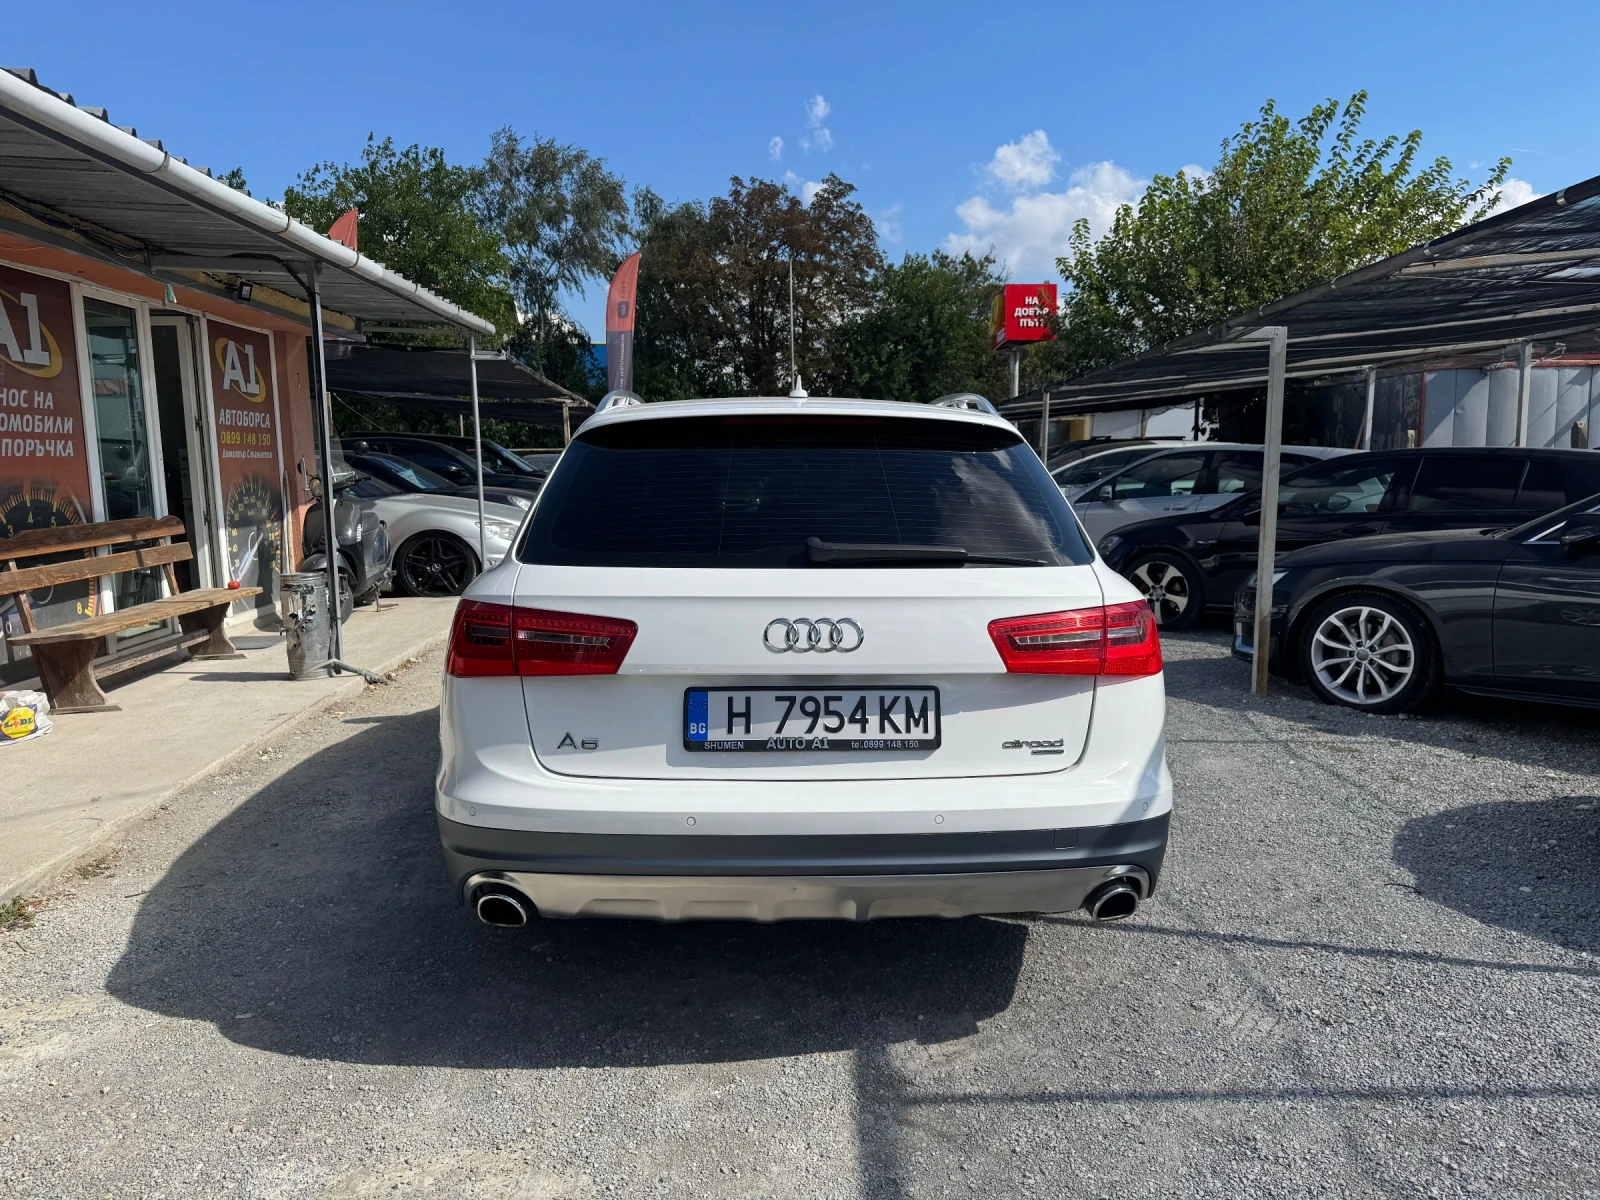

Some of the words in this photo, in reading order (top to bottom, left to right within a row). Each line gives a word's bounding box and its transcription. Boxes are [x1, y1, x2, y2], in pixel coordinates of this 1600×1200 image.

[1025, 296, 1039, 305] НА
[222, 340, 260, 395] A1
[34, 390, 54, 410] НА
[219, 408, 271, 429] АВТОБОРСА
[220, 430, 241, 445] 0899
[243, 432, 257, 445] 148
[258, 433, 271, 446] 150
[1, 438, 74, 457] ПОРЪЧКА
[27, 511, 34, 524] 4
[50, 516, 57, 528] 5
[7, 525, 14, 538] 3
[76, 601, 83, 614] 8
[726, 695, 751, 735] H
[774, 695, 869, 734] 7954
[878, 695, 929, 734] KM
[689, 722, 706, 735] BG
[556, 731, 600, 750] A6
[704, 741, 744, 750] SHUMEN
[766, 736, 806, 750] AUTO
[811, 736, 830, 749] A1
[886, 740, 902, 749] 148
[904, 740, 919, 749] 150
